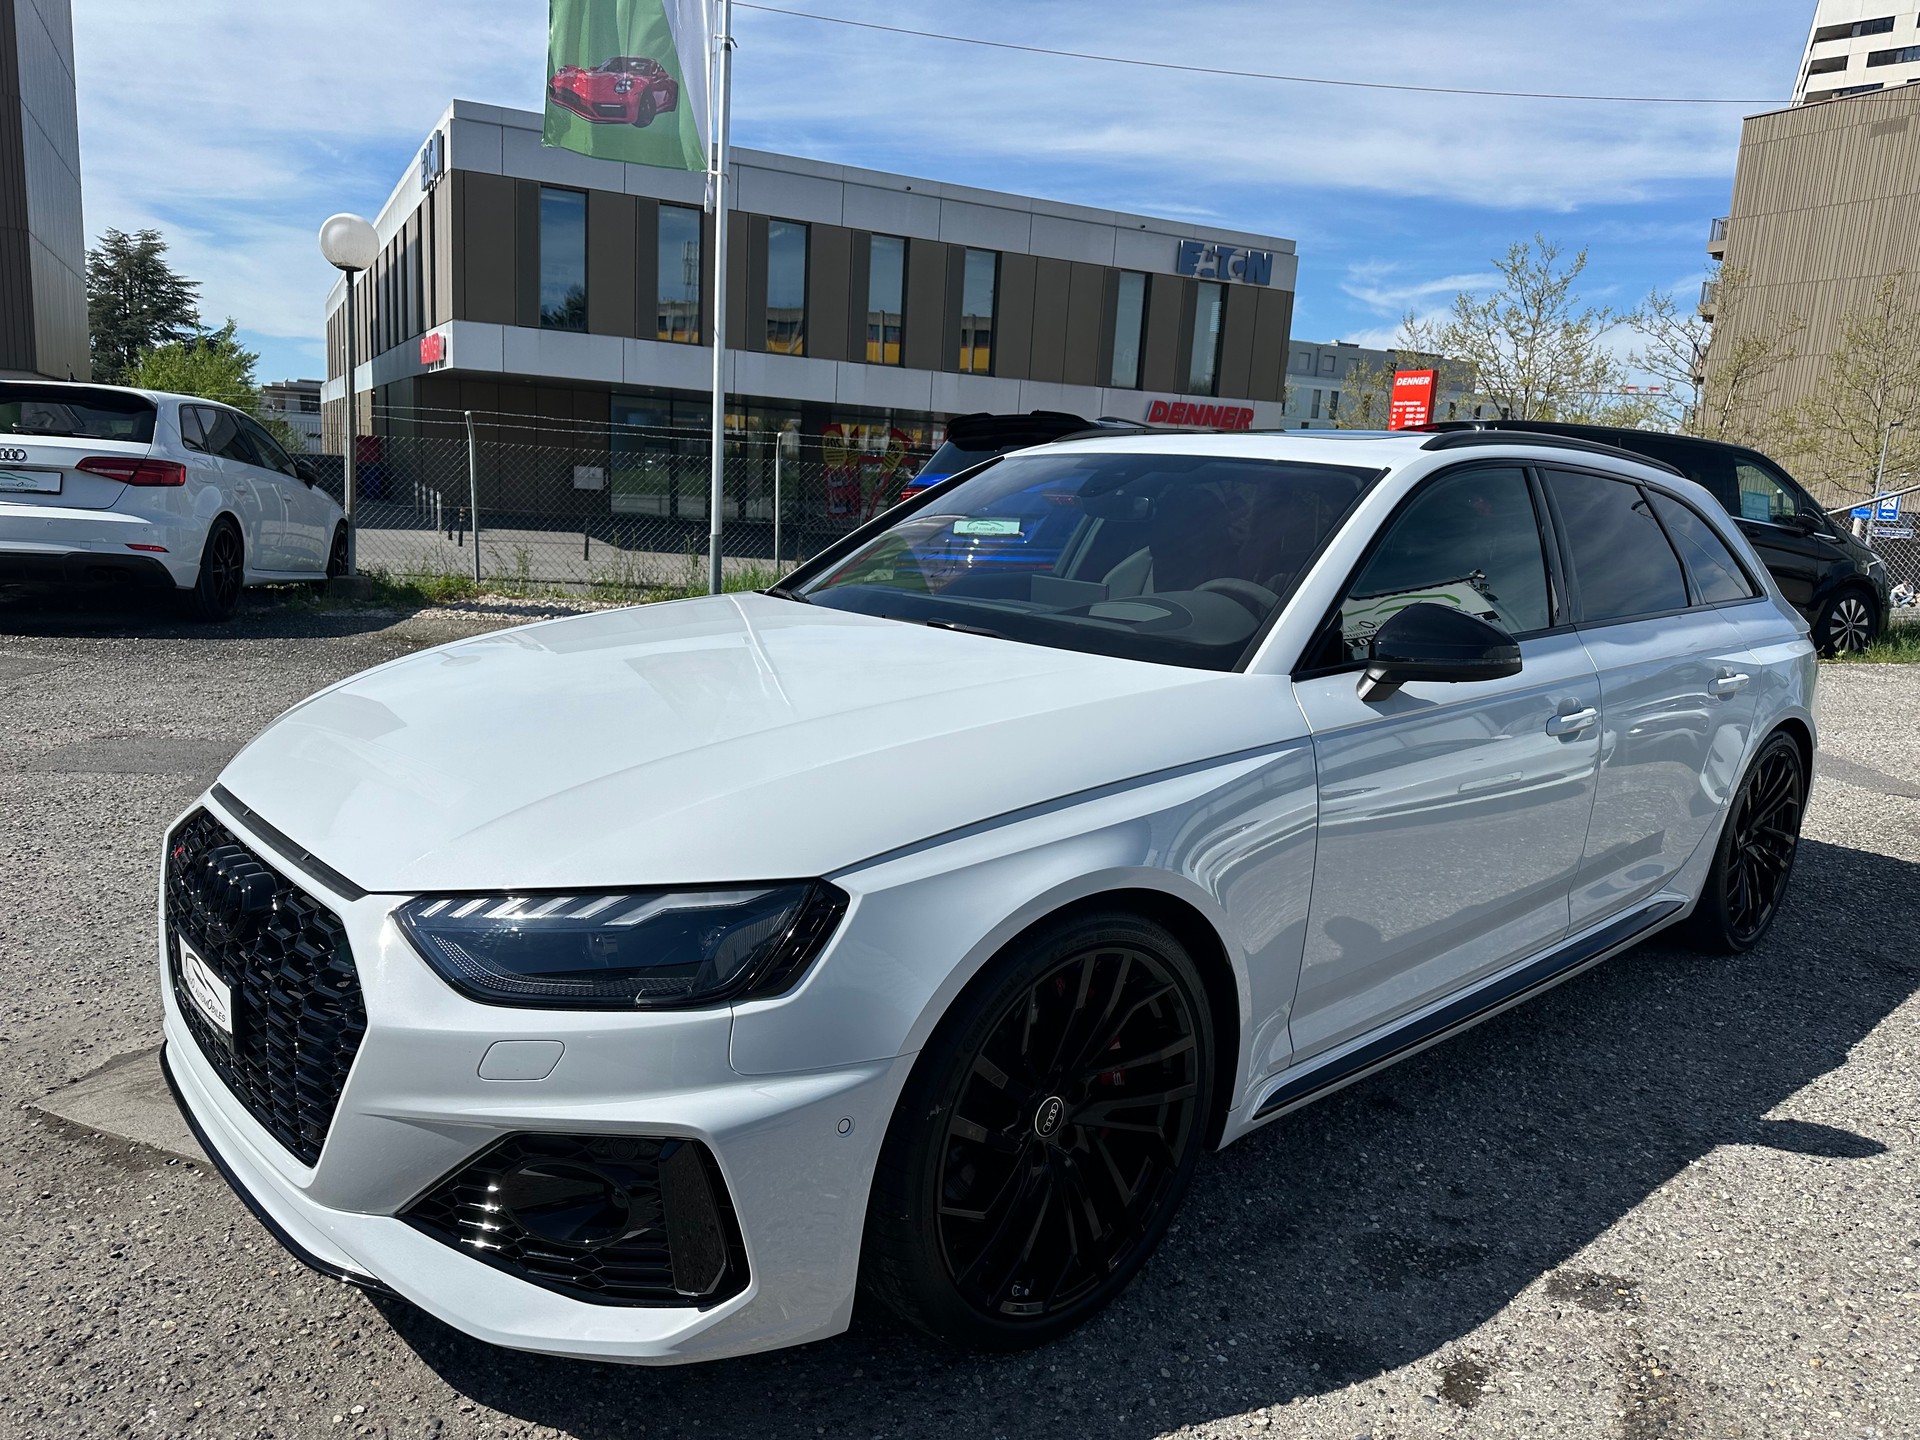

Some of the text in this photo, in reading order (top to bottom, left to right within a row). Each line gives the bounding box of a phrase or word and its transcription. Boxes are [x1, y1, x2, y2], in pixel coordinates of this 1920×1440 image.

[1177, 240, 1273, 286] EATON
[1395, 376, 1431, 386] DENNER
[1147, 400, 1255, 430] DENNER
